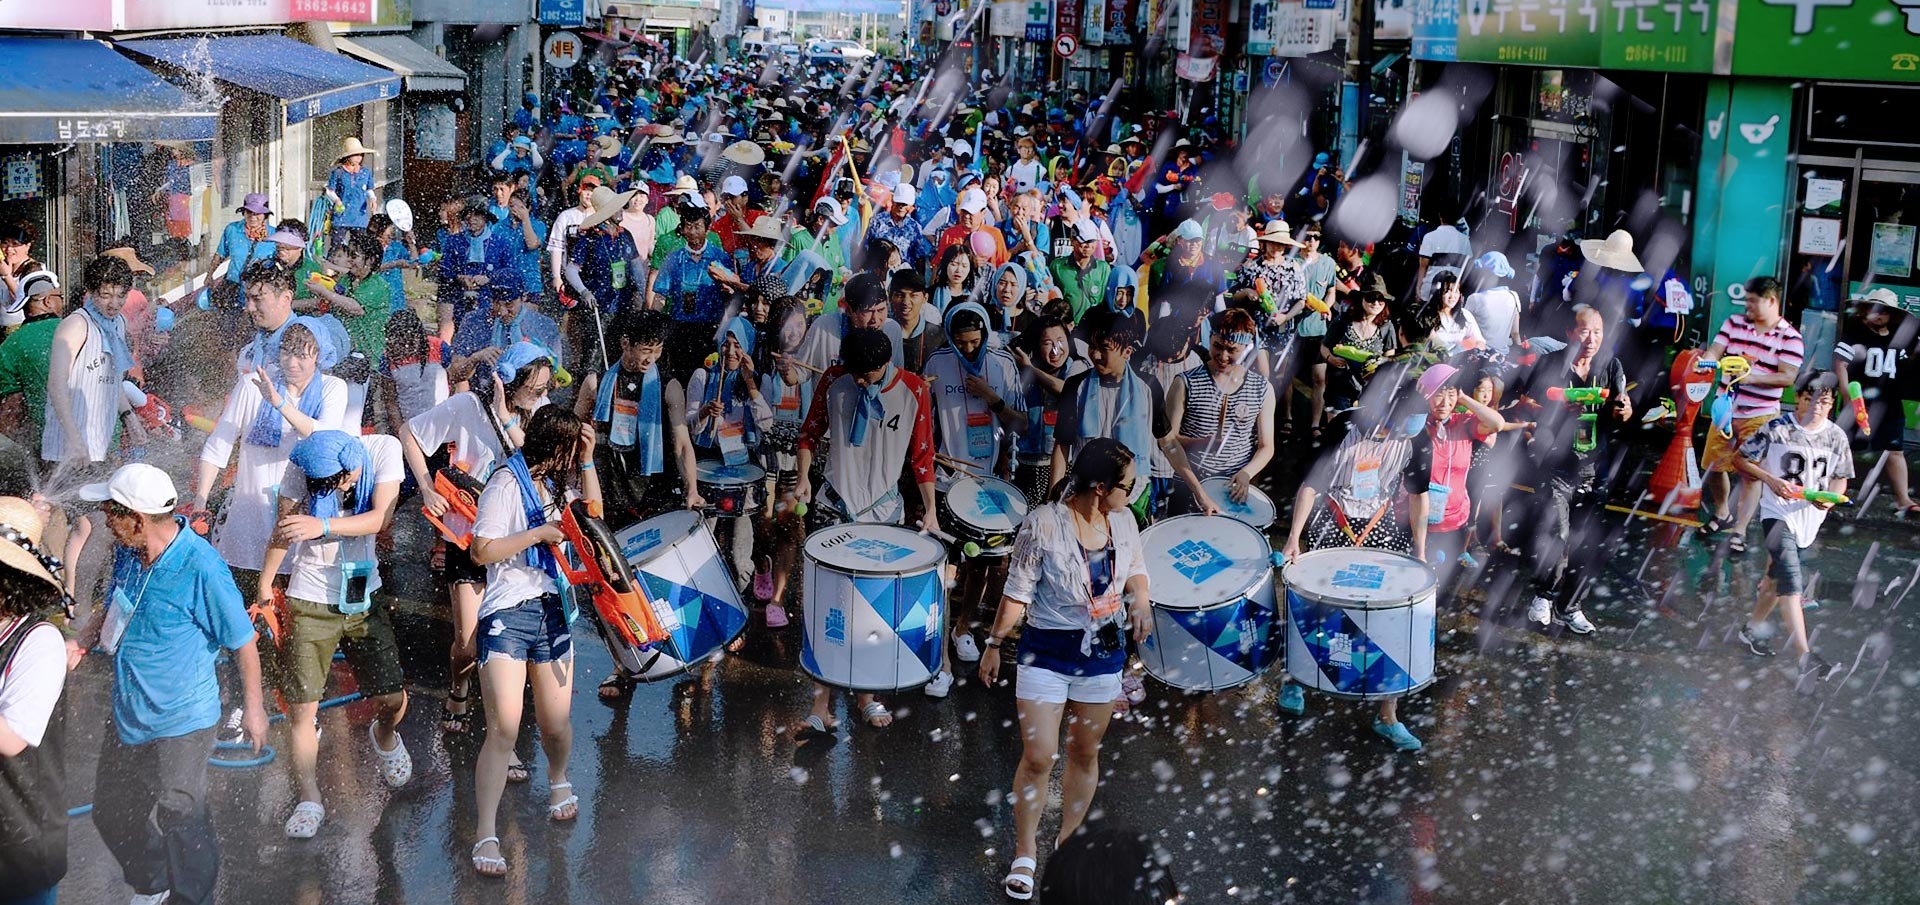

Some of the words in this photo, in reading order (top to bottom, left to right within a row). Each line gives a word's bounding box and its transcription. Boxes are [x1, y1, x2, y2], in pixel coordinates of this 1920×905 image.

[550, 40, 574, 59] 세탁
[1634, 45, 1687, 63] 864-4111
[58, 119, 125, 140] 남도쇼핑
[1864, 347, 1897, 379] 04
[820, 531, 857, 549] GOPE
